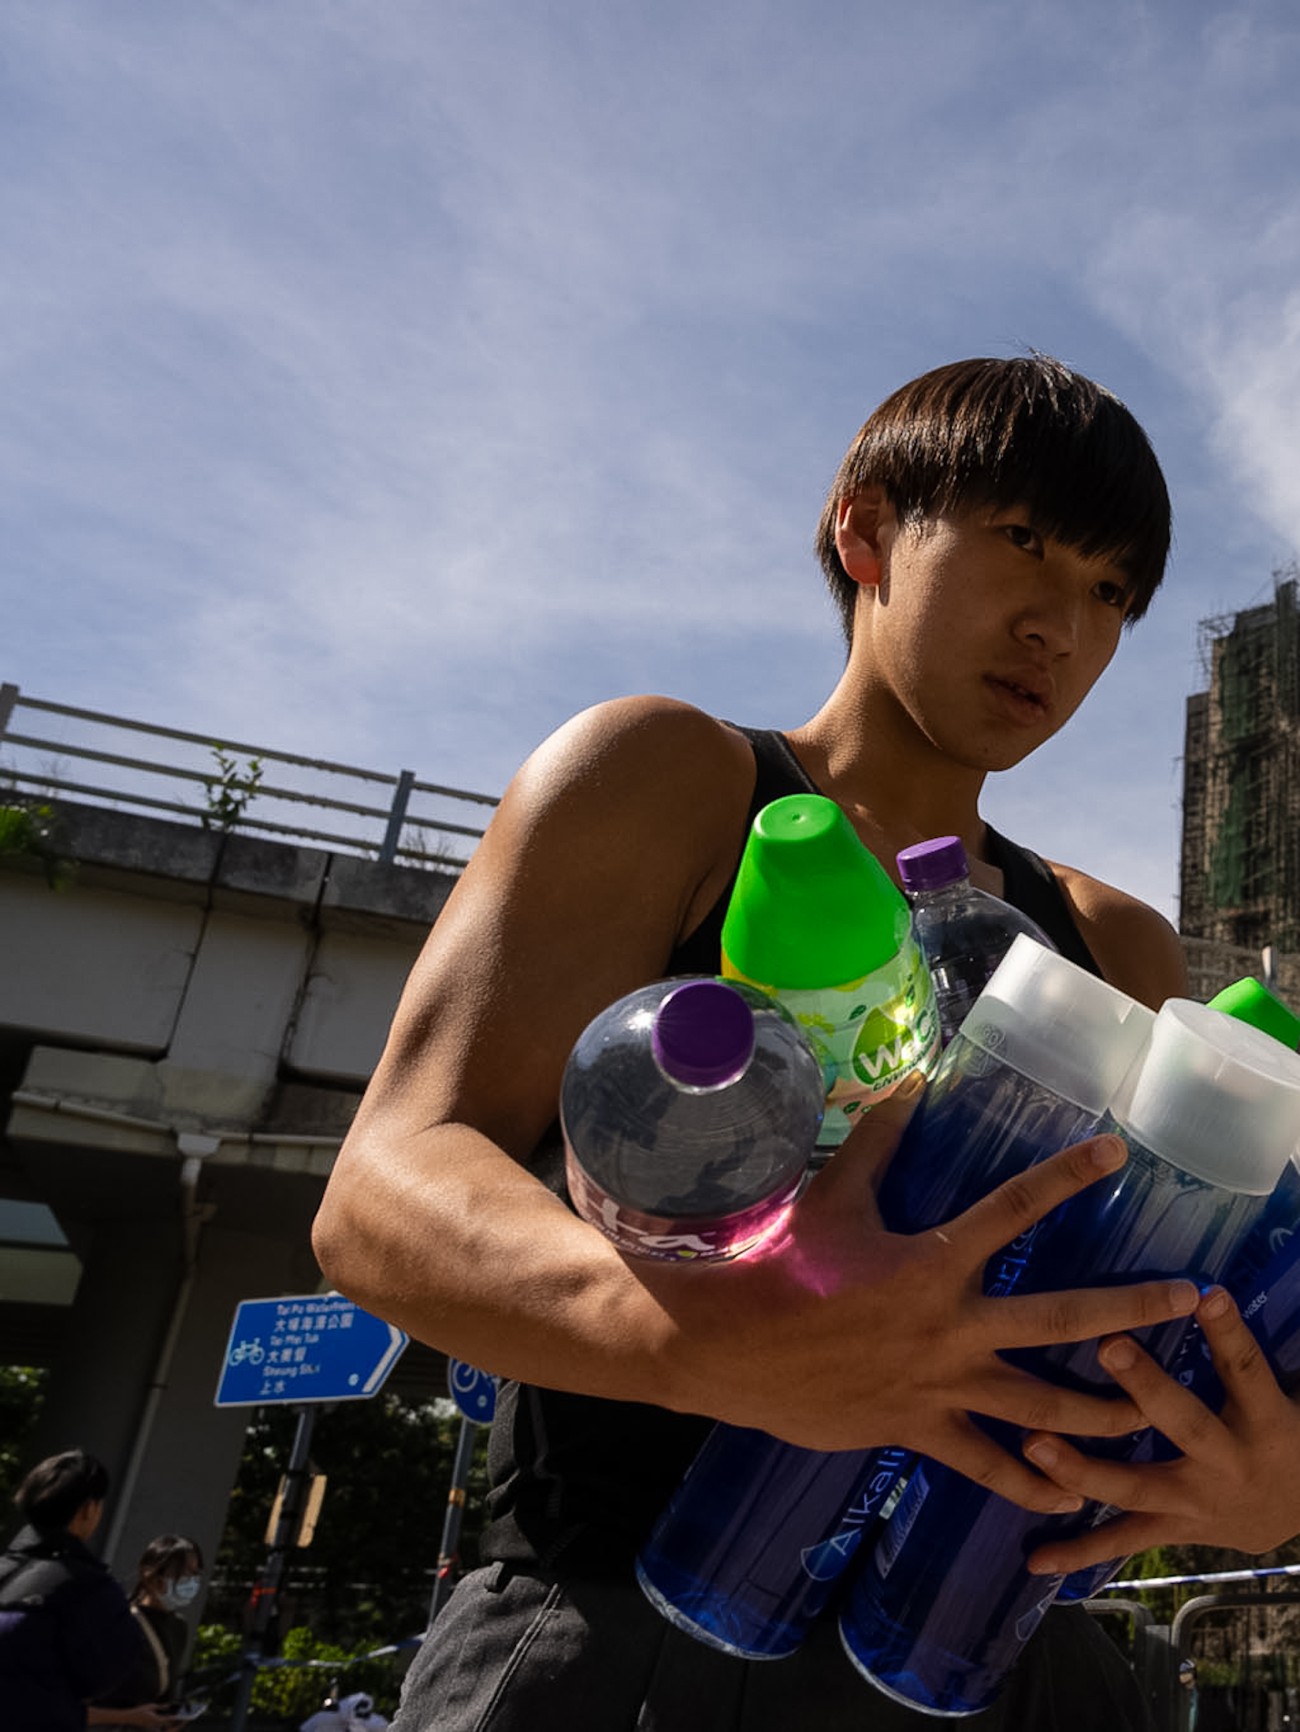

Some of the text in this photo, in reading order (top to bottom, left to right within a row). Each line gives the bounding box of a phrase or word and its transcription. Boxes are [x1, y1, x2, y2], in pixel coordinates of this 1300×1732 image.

[291, 1303, 304, 1314] Po
[1242, 1290, 1269, 1320] water
[263, 1365, 298, 1378] Sheung
[260, 1380, 286, 1395] 上水
